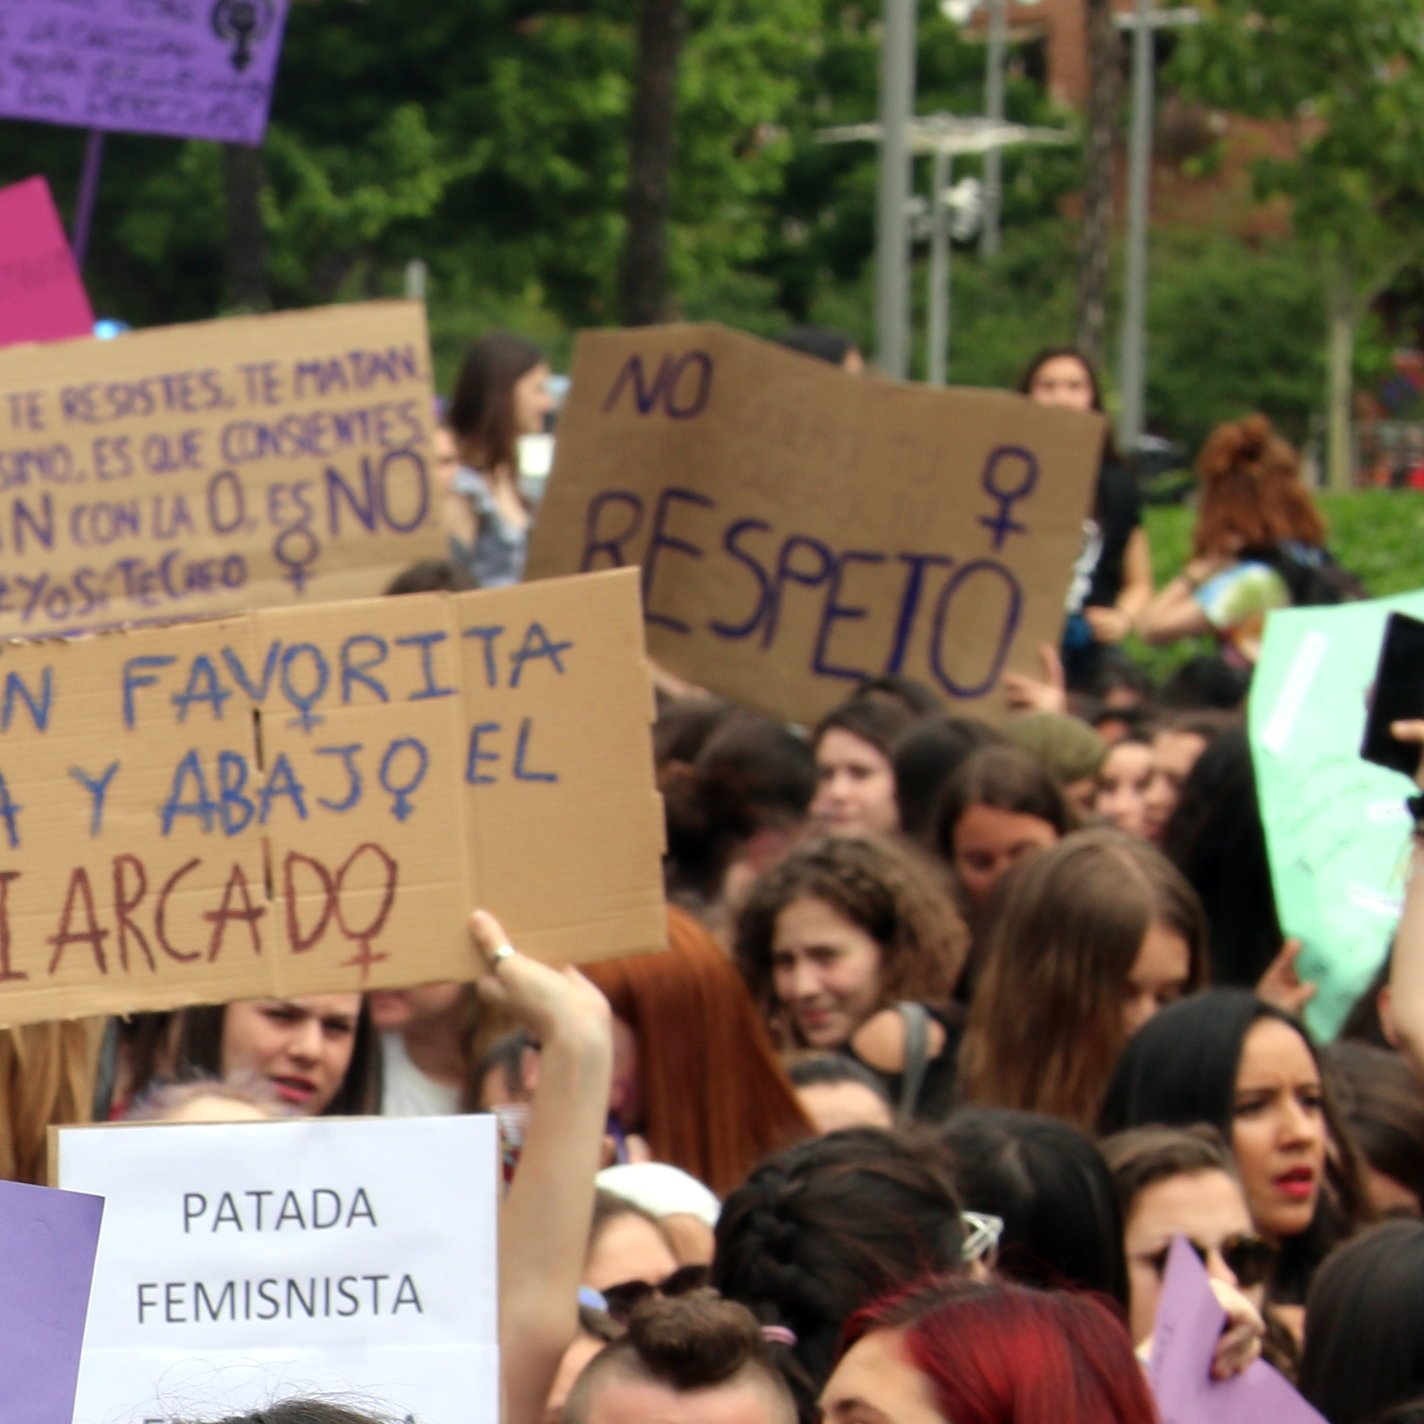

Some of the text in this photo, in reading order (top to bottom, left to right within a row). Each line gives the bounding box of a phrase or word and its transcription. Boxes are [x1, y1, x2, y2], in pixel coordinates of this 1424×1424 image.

[5, 390, 49, 432] TE
[239, 359, 283, 403] TE
[600, 349, 716, 420] NO
[91, 436, 133, 482] ES
[141, 429, 205, 476] QUE
[68, 501, 142, 551] CON
[151, 494, 196, 542] LA
[265, 481, 316, 527] ES
[324, 447, 432, 538] NO
[579, 487, 1025, 699] RESPETO
[123, 623, 576, 735] FAVORITA
[72, 761, 122, 837] Y
[158, 735, 429, 840] ABAJO
[468, 717, 560, 786] EL
[181, 1186, 380, 1235] PATADA
[136, 1273, 424, 1325] FEMISNISTA
